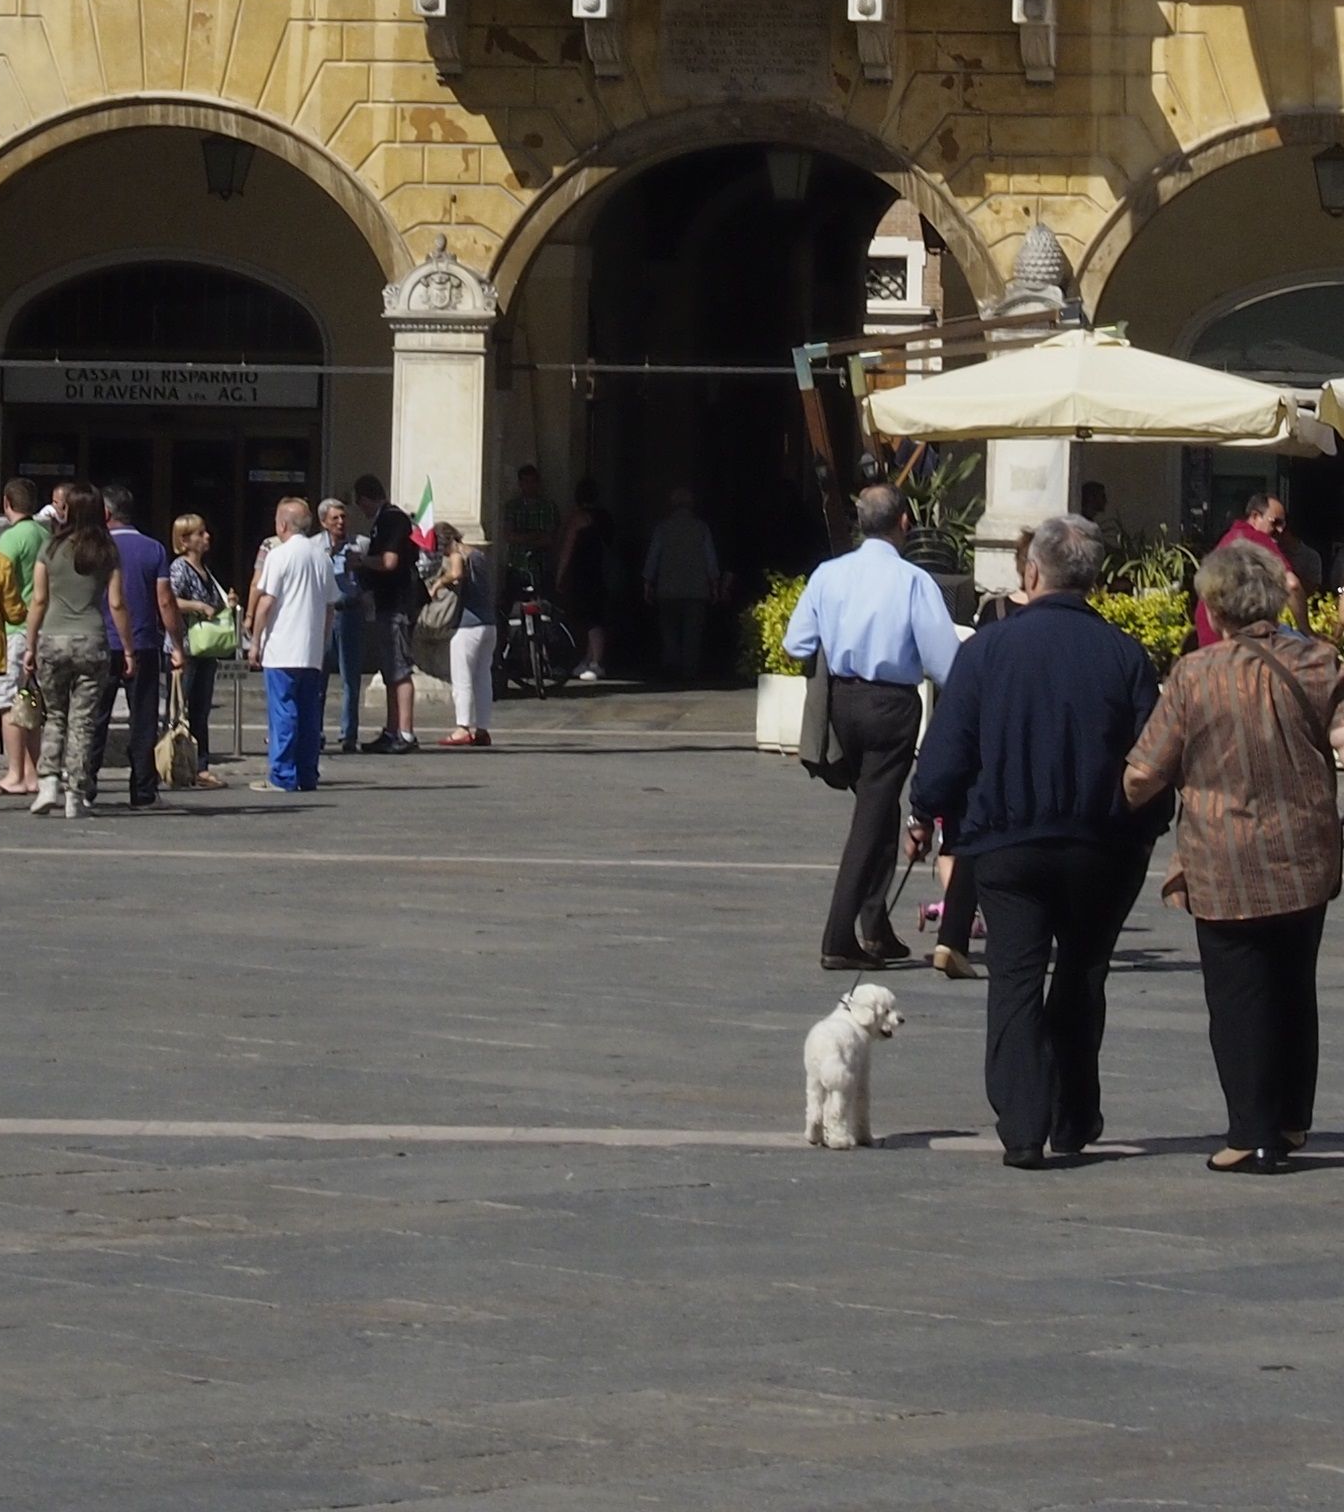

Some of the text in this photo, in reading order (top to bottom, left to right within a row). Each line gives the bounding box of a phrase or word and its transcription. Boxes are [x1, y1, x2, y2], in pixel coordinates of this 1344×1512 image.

[65, 368, 259, 385] CASSA DI RISPARMIO
[65, 384, 84, 399] DI
[93, 384, 180, 401] RAVENNA
